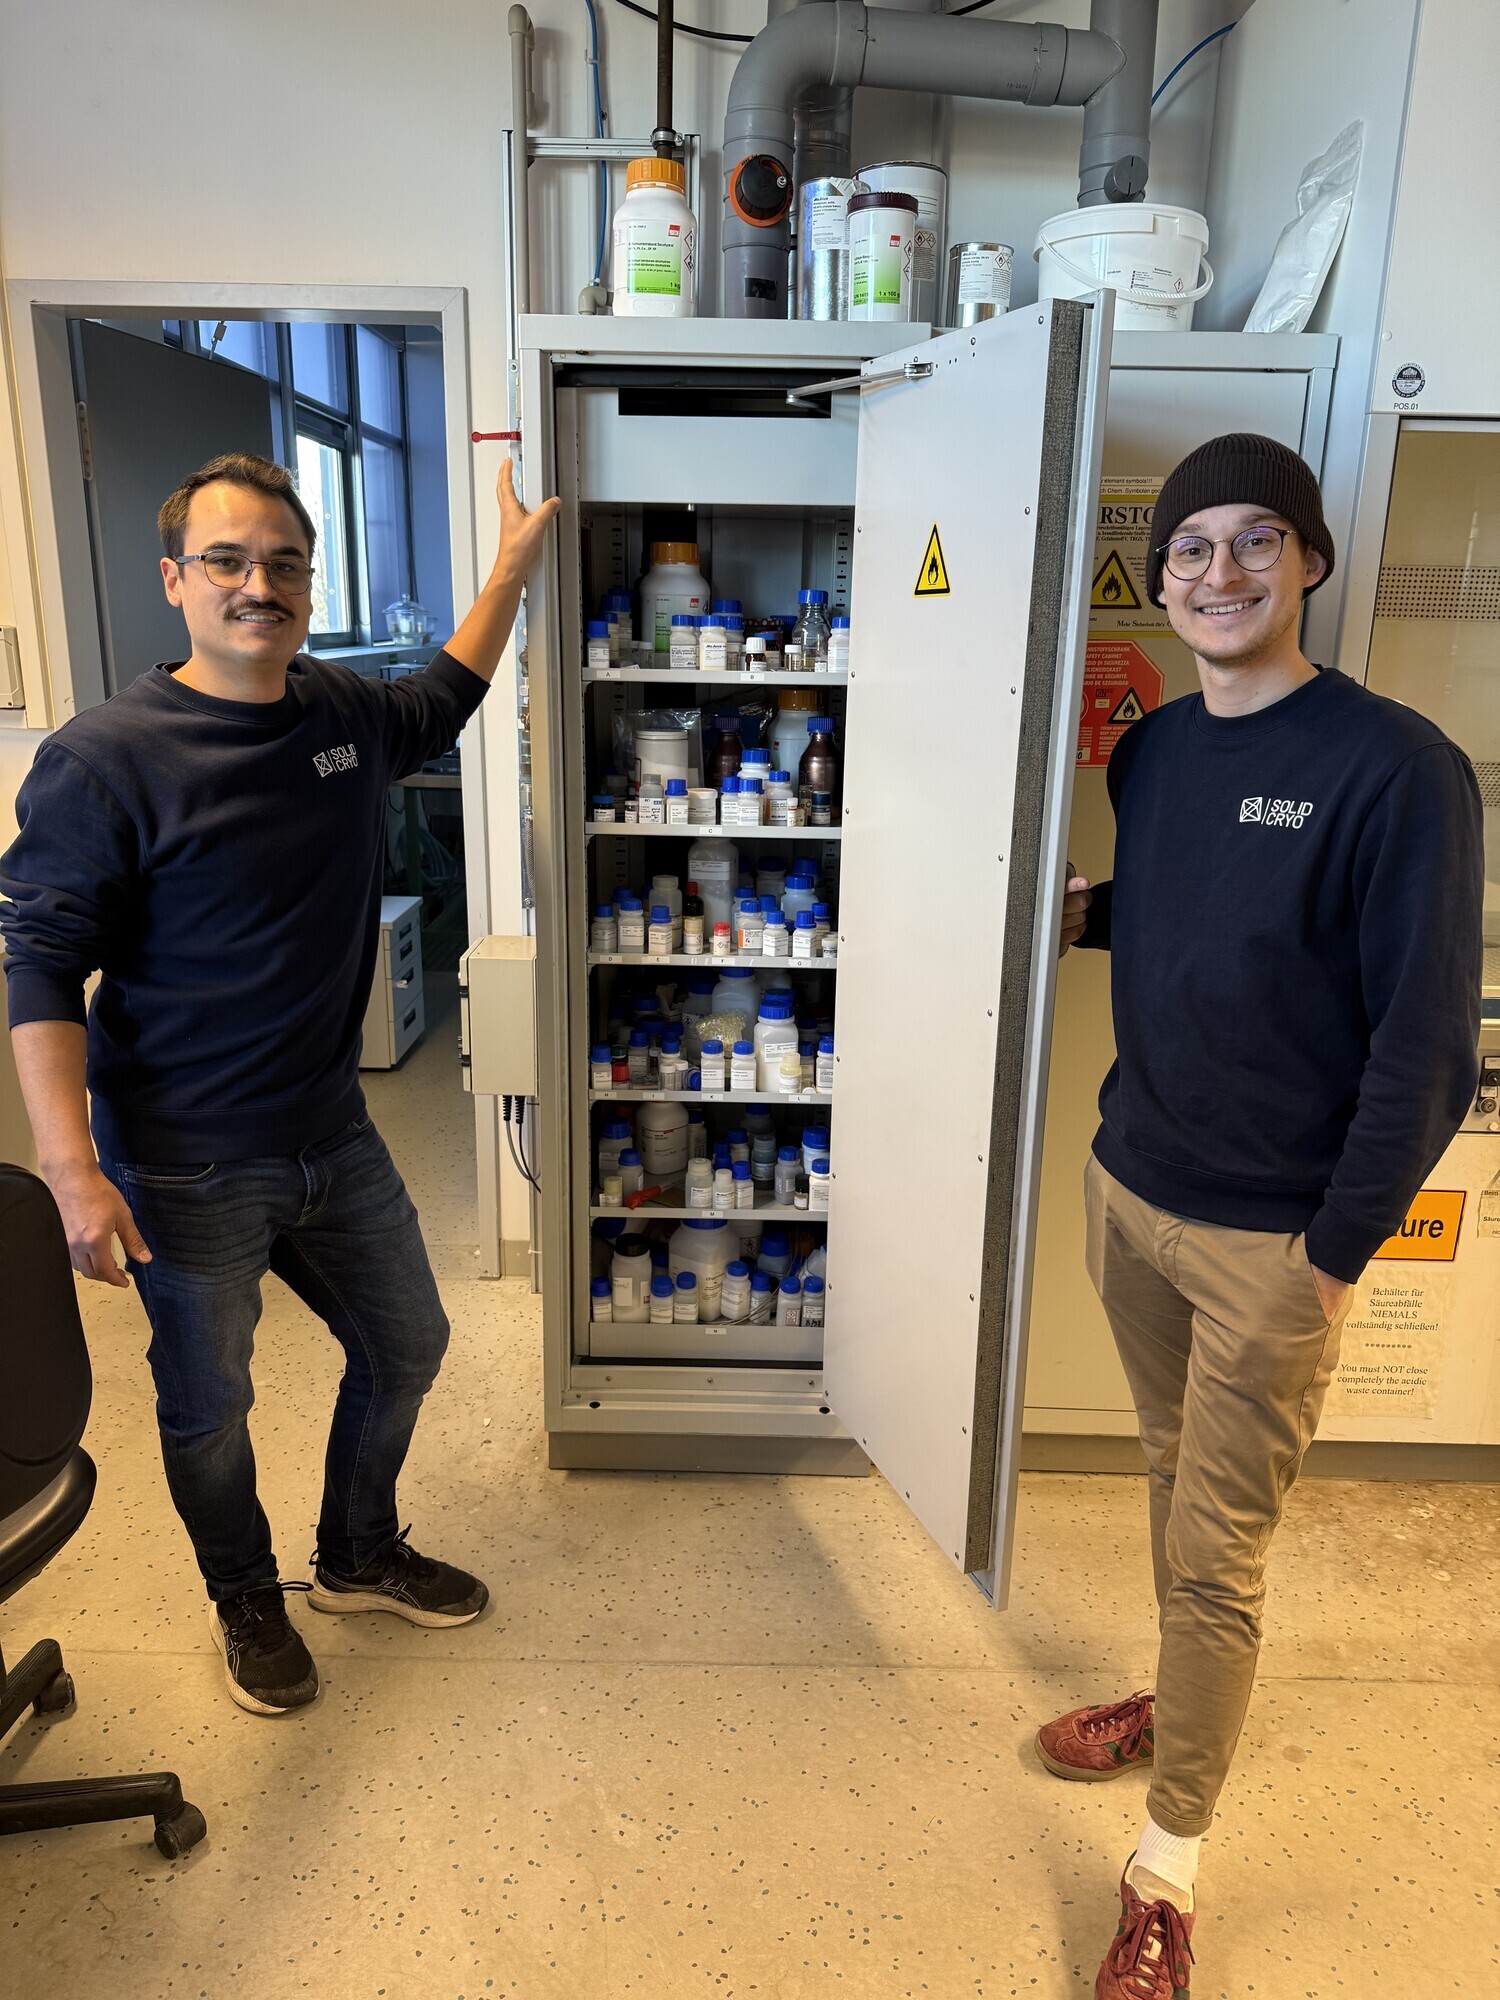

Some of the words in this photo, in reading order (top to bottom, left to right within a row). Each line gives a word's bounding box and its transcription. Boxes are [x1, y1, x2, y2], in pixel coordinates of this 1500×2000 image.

[330, 743, 357, 760] SOLID
[335, 755, 358, 771] CRYO
[1270, 799, 1313, 816] SOLID
[1265, 812, 1304, 829] CRYO
[1400, 1218, 1444, 1238] ure
[1372, 1288, 1409, 1296] Behälter
[1411, 1288, 1424, 1297] für
[1369, 1299, 1423, 1308] Säureabfälle
[1370, 1310, 1418, 1319] NIEMALS
[1346, 1321, 1392, 1331] vollständig
[1395, 1322, 1439, 1331] schließen!
[1341, 1364, 1357, 1372] You
[1406, 1366, 1428, 1374] close
[1337, 1376, 1384, 1385] completely
[1401, 1377, 1427, 1385] acidic
